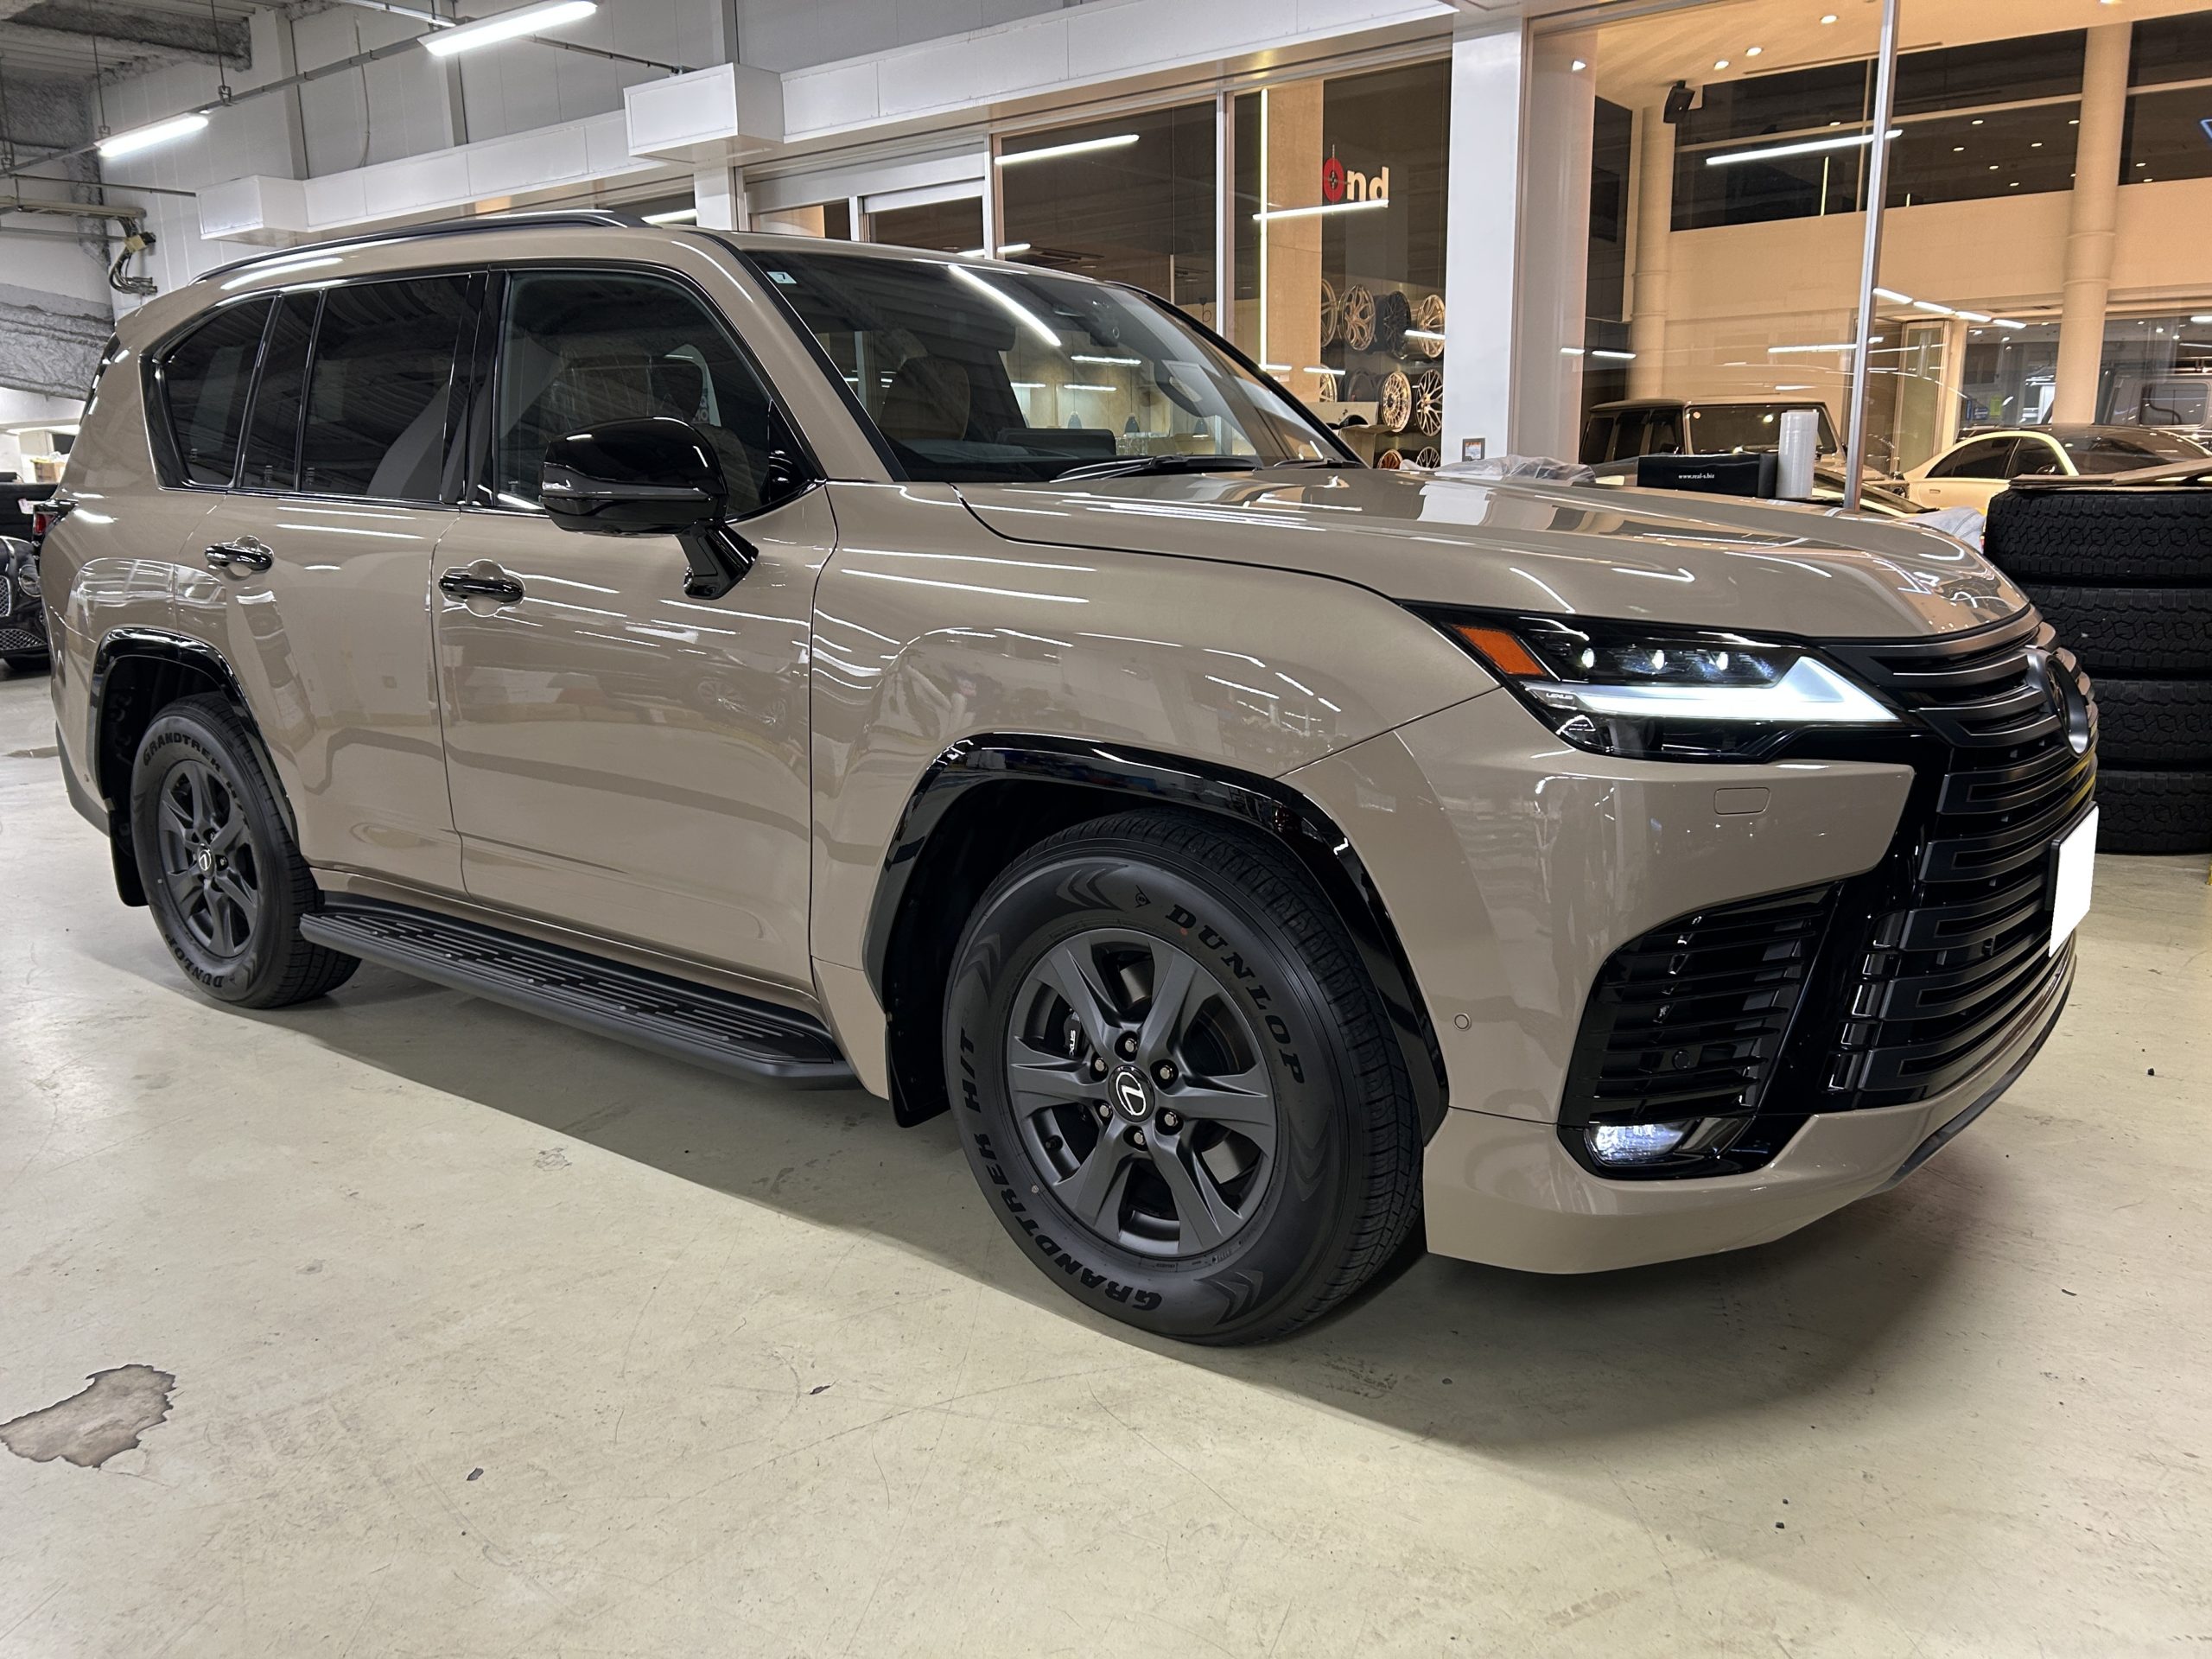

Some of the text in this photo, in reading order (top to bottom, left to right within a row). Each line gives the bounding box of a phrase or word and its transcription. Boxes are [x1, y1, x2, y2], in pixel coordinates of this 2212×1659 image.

[164, 933, 225, 988] DUNLOP
[1165, 904, 1306, 1084] DUNLOP
[959, 1026, 1163, 1312] GRANDTREK H/T
